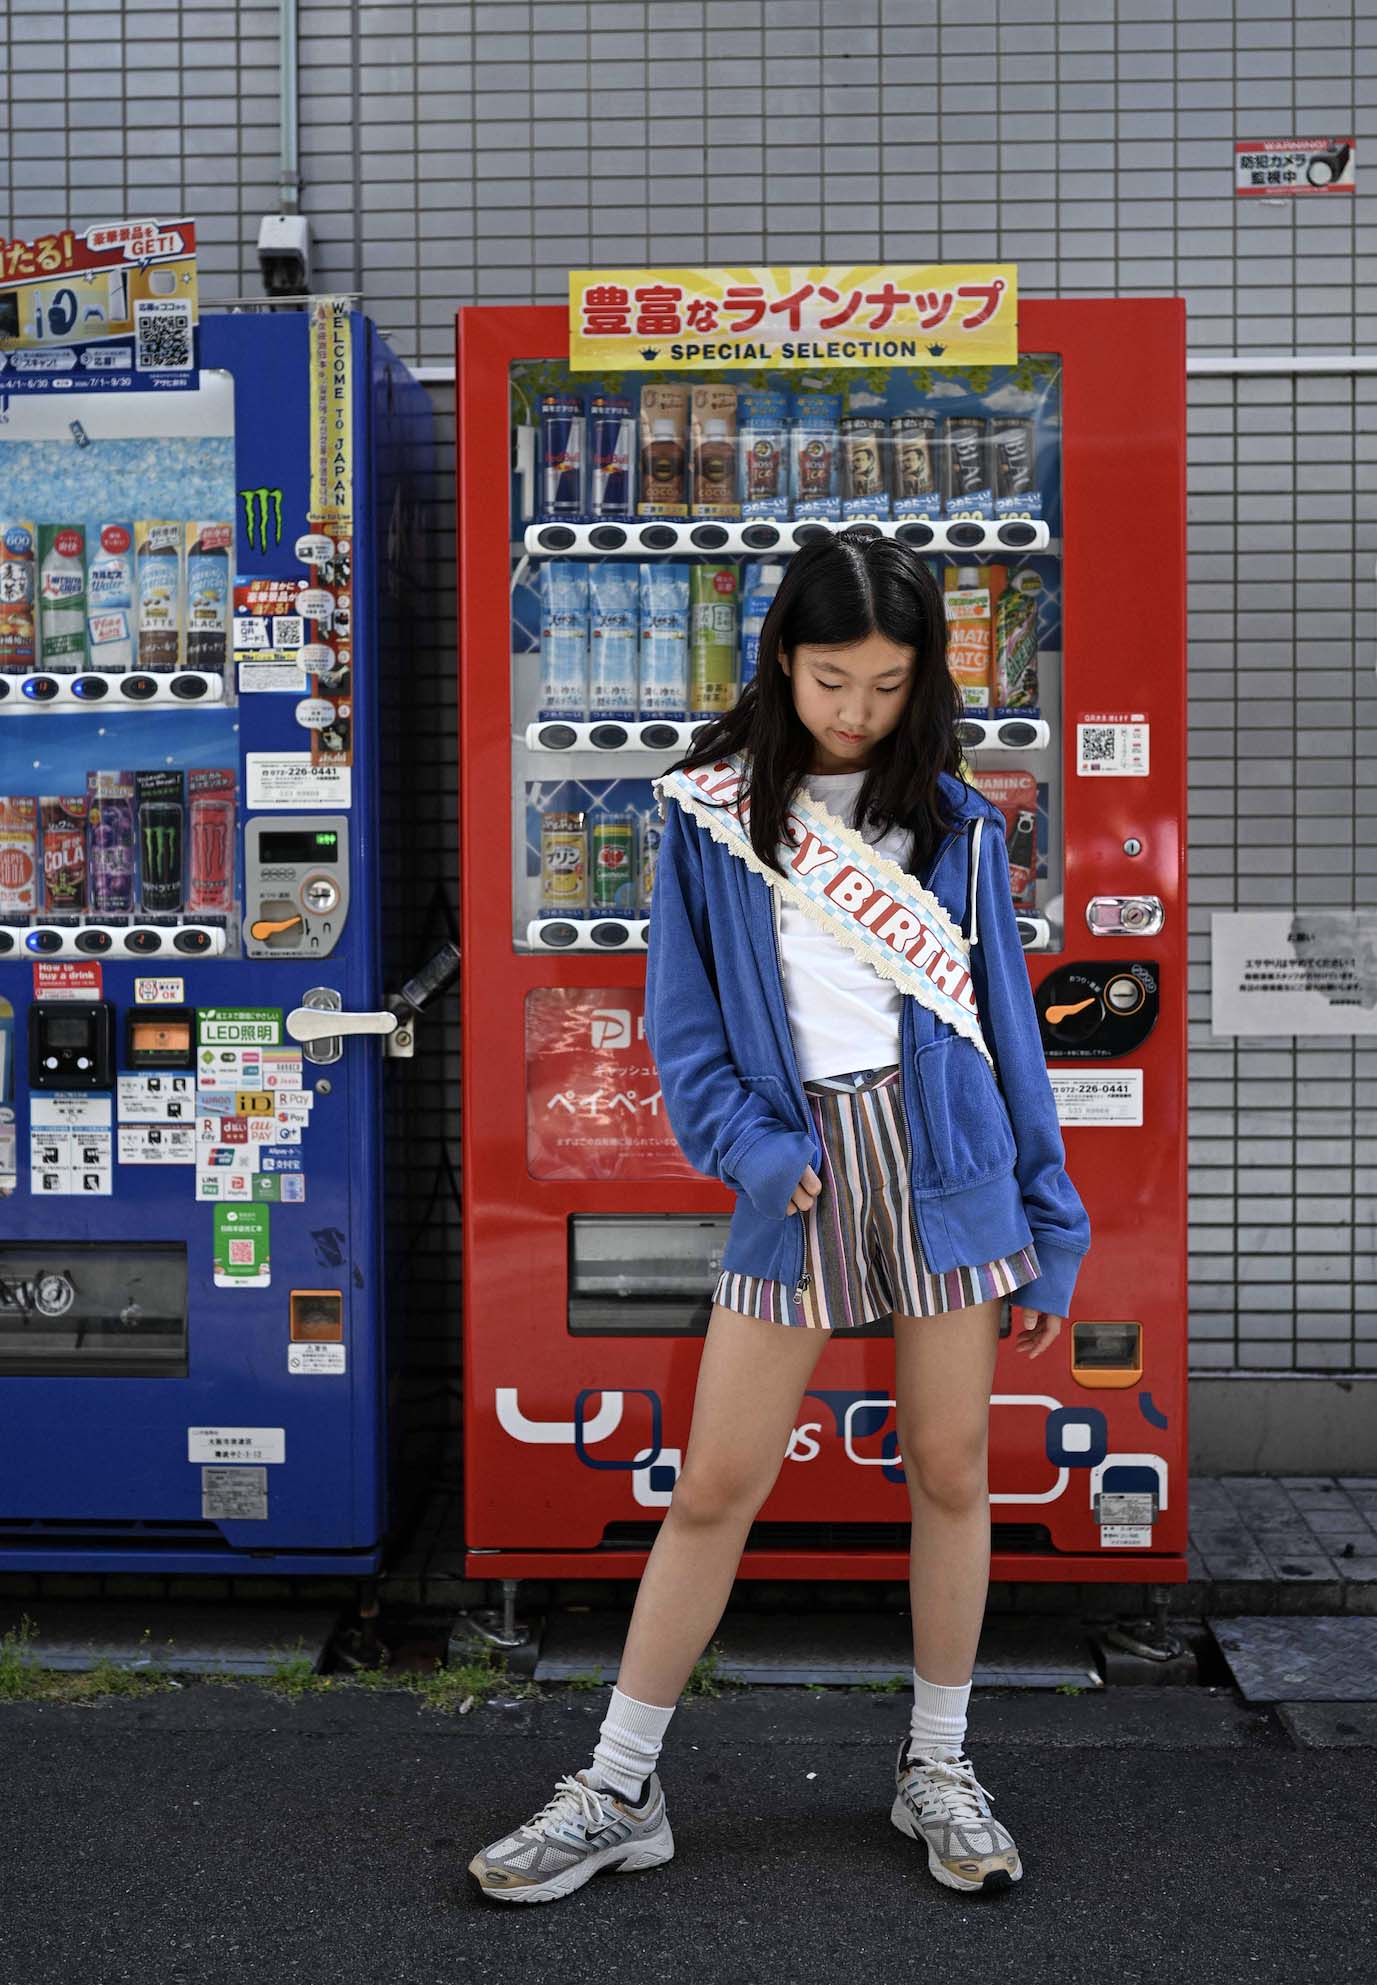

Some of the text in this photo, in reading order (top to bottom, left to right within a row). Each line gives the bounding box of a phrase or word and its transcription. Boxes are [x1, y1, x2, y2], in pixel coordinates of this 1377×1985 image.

[1241, 153, 1306, 169] 防犯カメラ
[1251, 170, 1297, 185] 監視中
[131, 237, 175, 256] GET!
[0, 234, 74, 277] たる!
[583, 281, 1005, 334] 豊富なラインナップ
[671, 341, 917, 361] SPECIAL SELECTION
[332, 302, 345, 506] WELCOME TO JAPAN
[44, 848, 84, 873] COLA
[39, 963, 60, 971] How
[69, 971, 95, 980] drink
[206, 1025, 272, 1041] LED照明
[1060, 1084, 1129, 1094] 072-226-0441
[241, 1096, 272, 1111] iD
[290, 1094, 309, 1106] Pay
